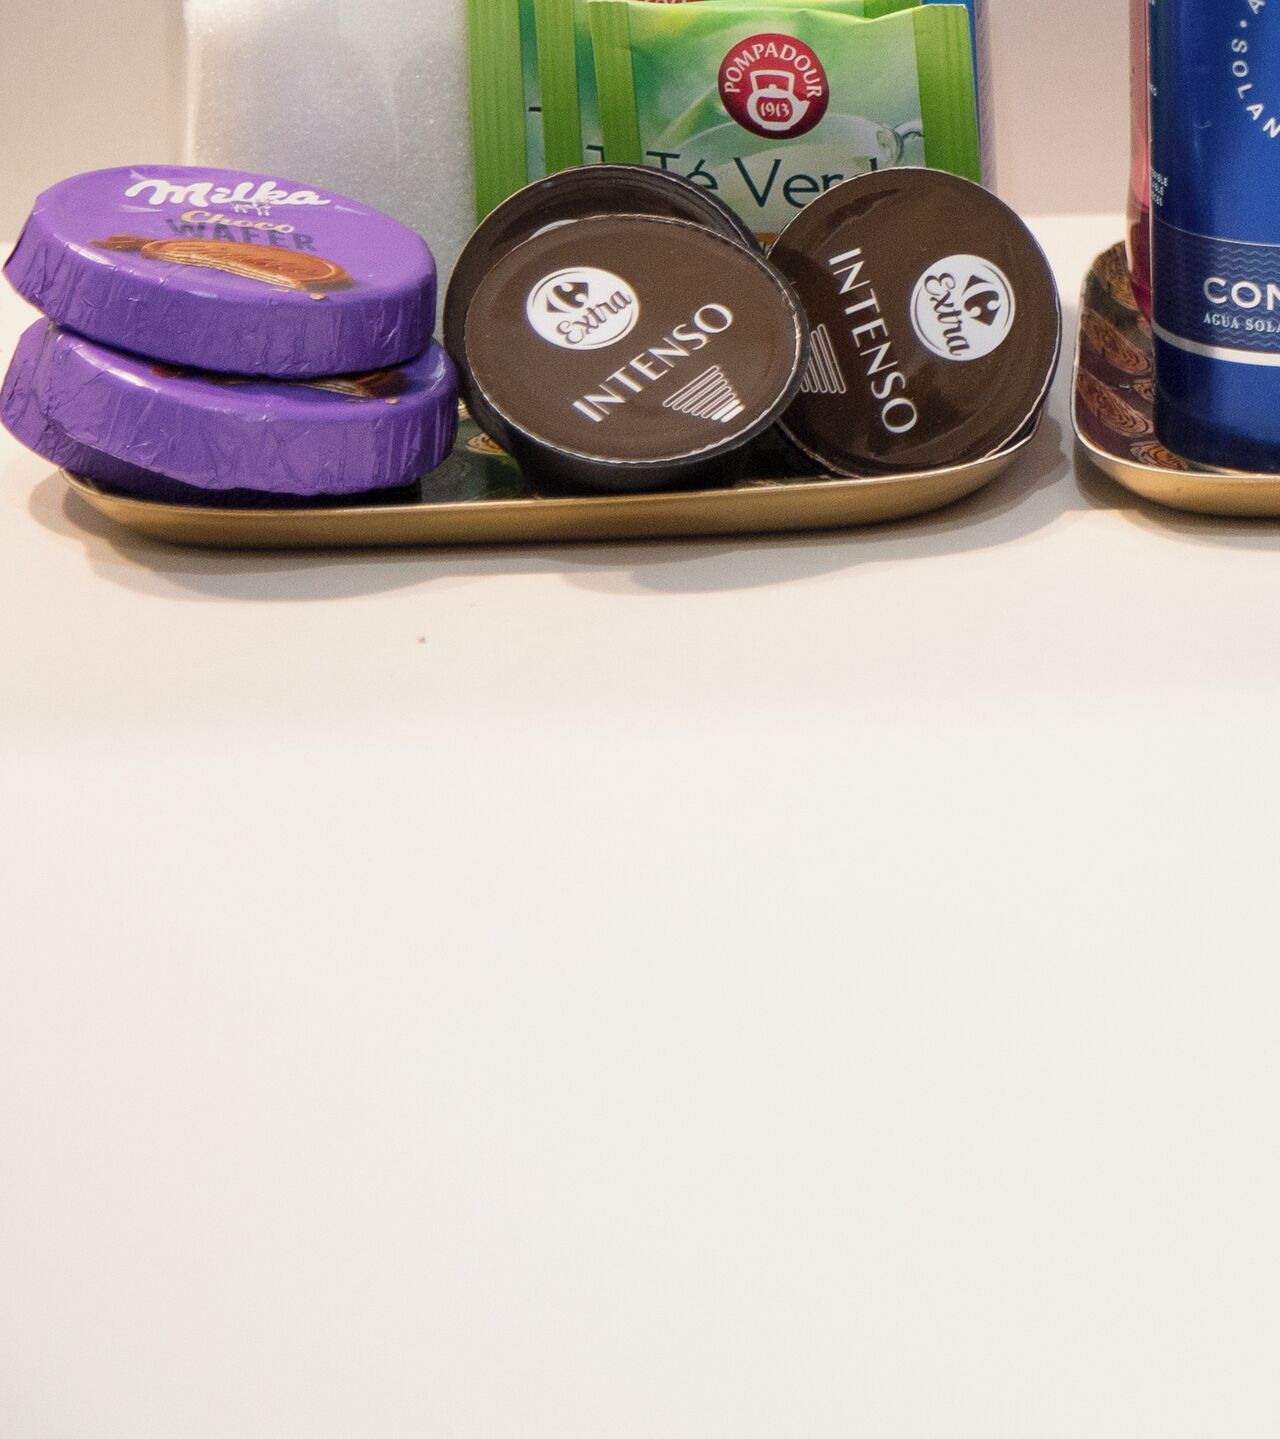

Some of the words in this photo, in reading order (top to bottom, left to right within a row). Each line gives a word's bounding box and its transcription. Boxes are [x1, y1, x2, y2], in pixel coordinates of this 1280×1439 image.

[724, 41, 823, 99] POMPADOUR
[760, 102, 790, 118] 1913
[124, 179, 331, 208] Milka
[165, 218, 319, 252] WAFER
[180, 210, 295, 234] Choco
[556, 290, 633, 345] Extra
[923, 272, 970, 357] Extra
[1203, 312, 1241, 330] AGUA
[828, 247, 918, 434] INTENSO
[572, 303, 733, 423] INTENSO
